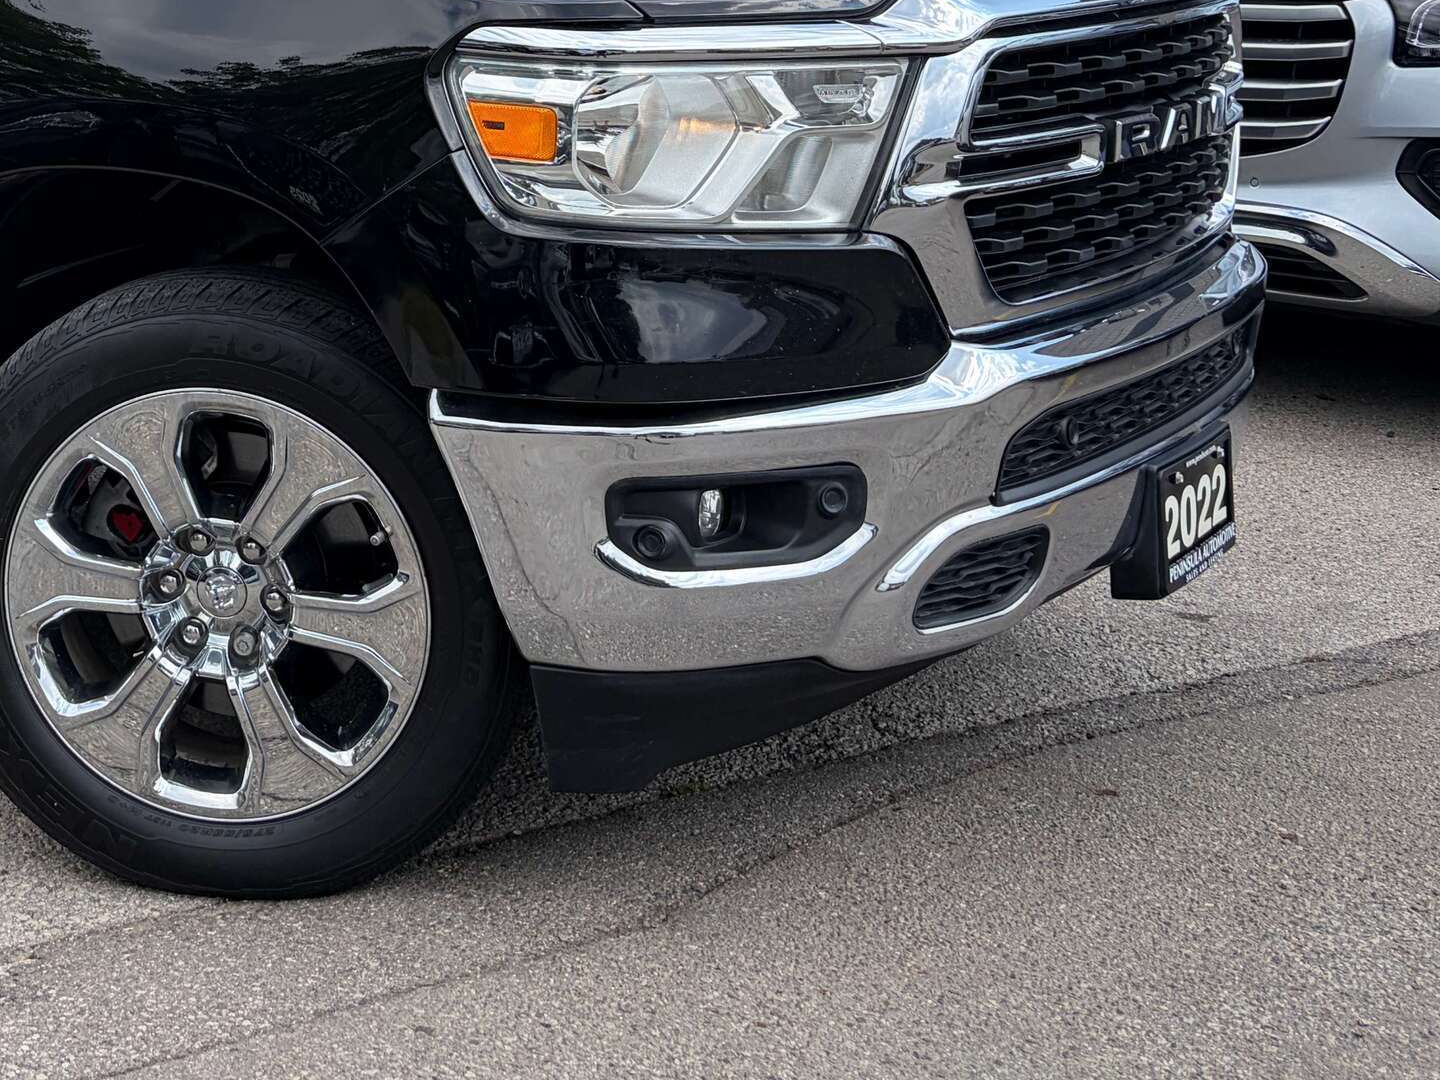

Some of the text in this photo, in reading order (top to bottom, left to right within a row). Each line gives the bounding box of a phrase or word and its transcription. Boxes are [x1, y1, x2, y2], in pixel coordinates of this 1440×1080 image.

[1114, 91, 1227, 163] RAM
[1165, 464, 1227, 559] 2022
[1169, 522, 1237, 583] PENINSULA AUTOMOTIVE
